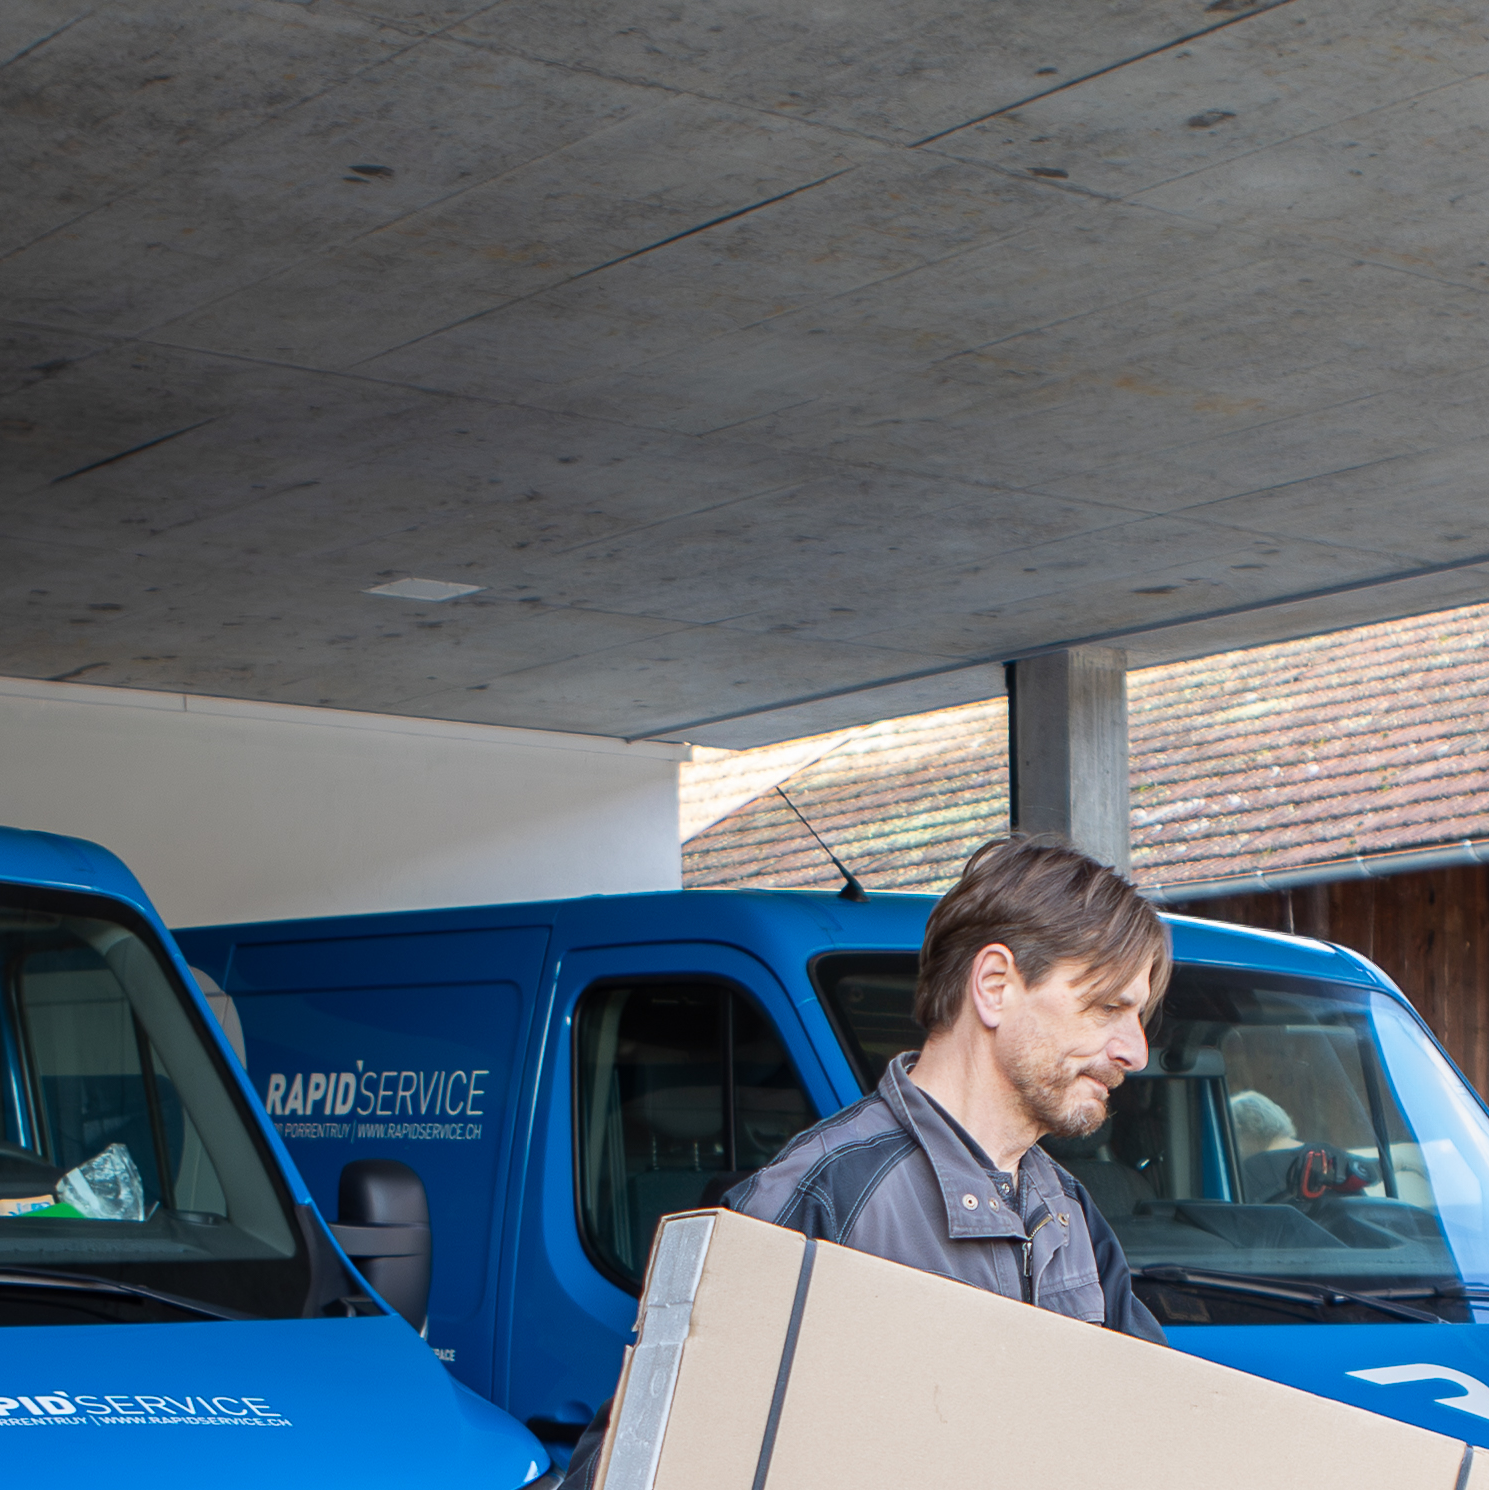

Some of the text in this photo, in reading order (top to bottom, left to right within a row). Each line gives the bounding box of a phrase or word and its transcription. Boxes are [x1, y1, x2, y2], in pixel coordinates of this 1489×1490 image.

[284, 1122, 351, 1138] PORRENTRUY
[357, 1122, 482, 1140] WWW.RAPIDSERVICE.CH
[98, 1415, 293, 1428] WWW.RAPIDSERVICE.CH
